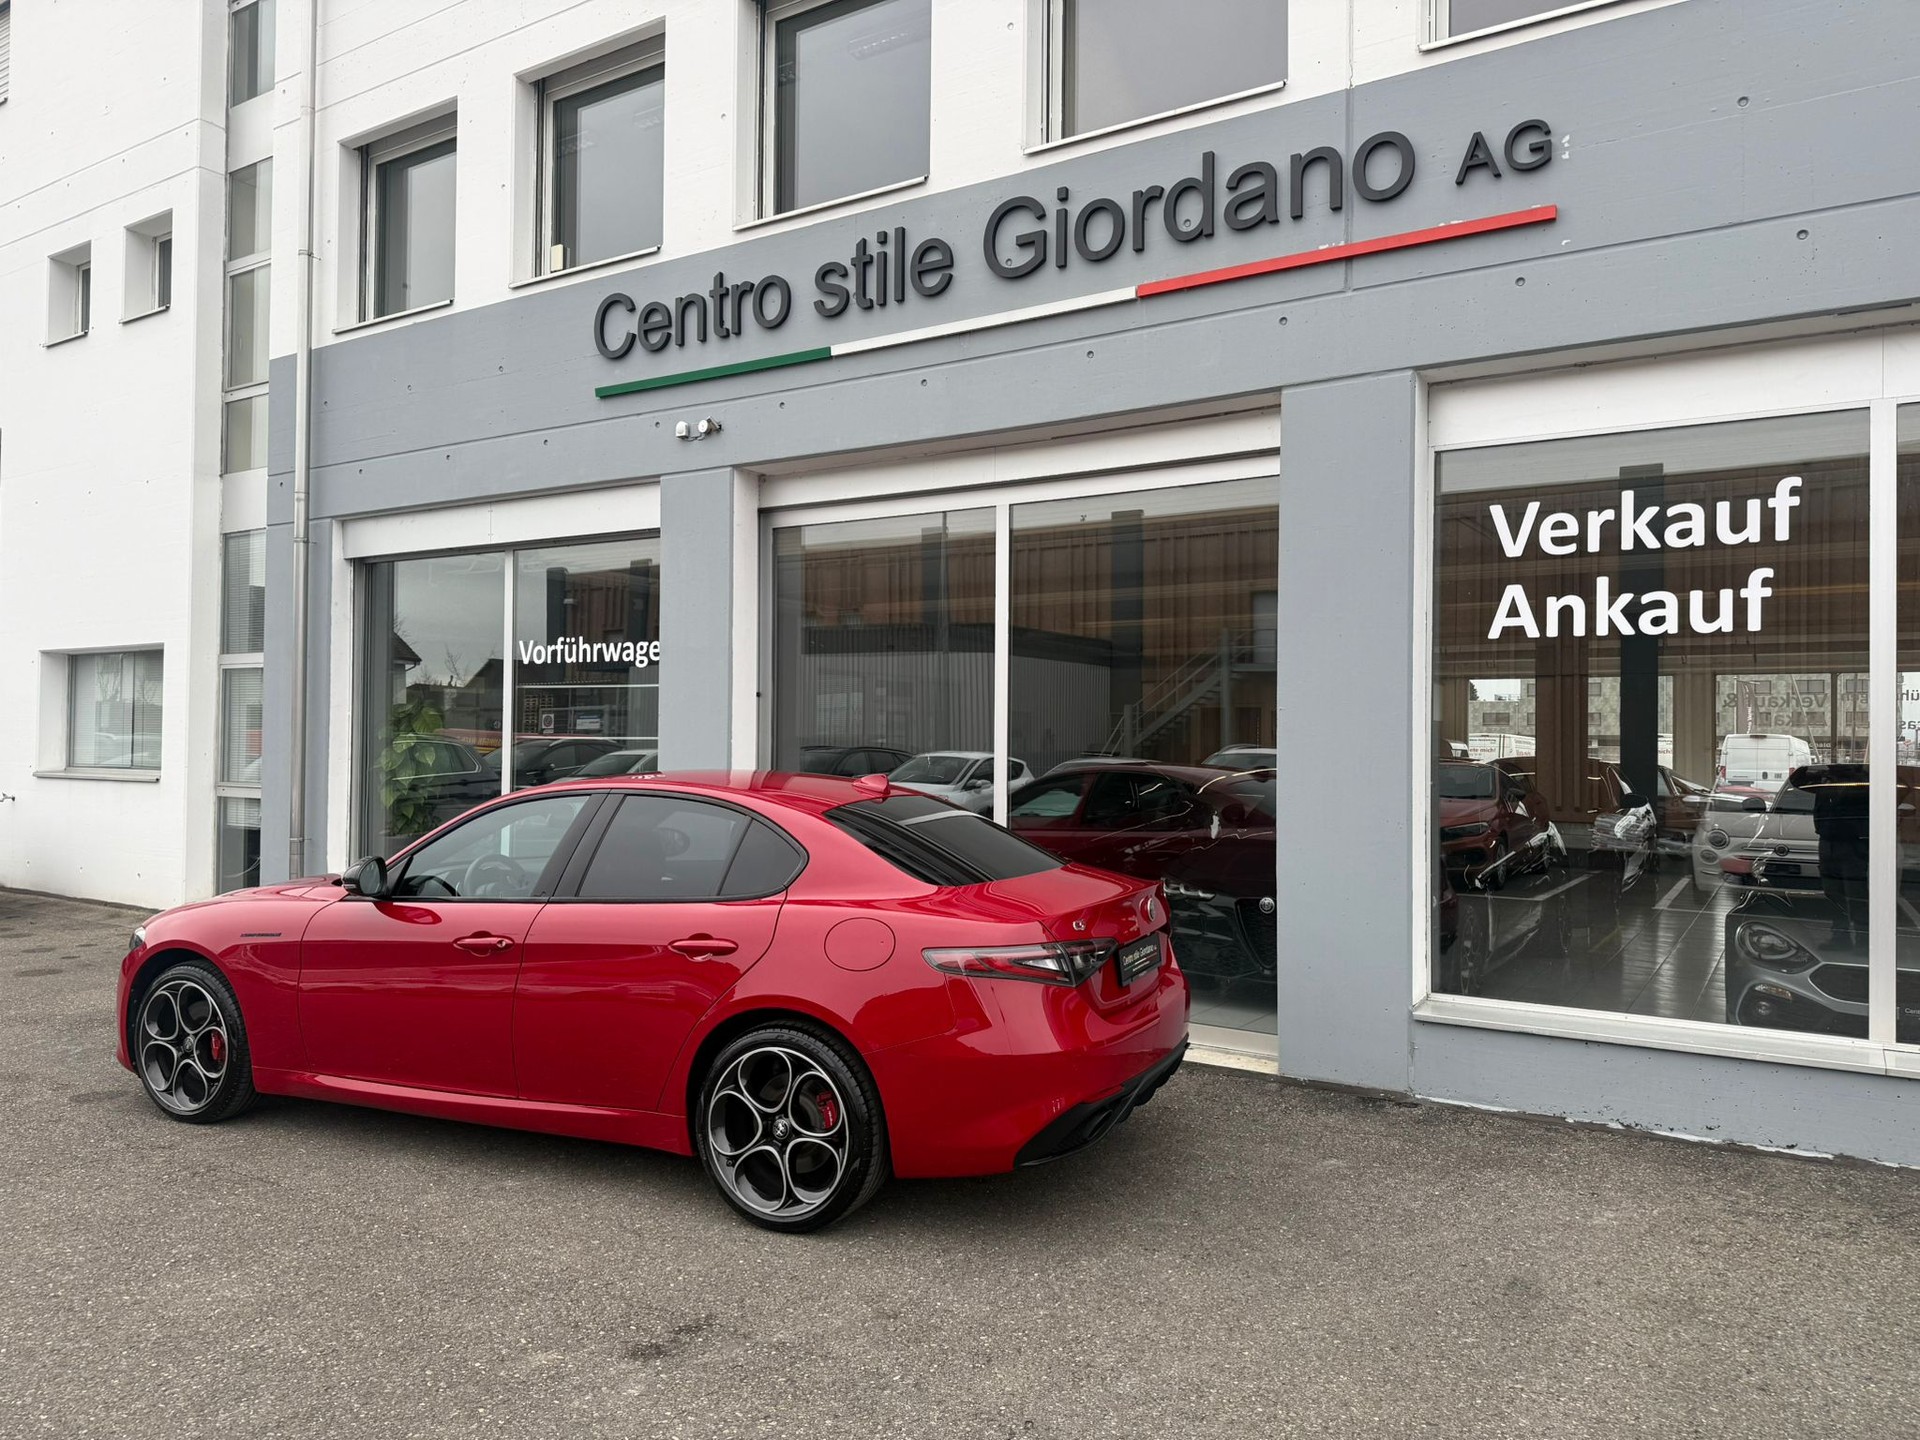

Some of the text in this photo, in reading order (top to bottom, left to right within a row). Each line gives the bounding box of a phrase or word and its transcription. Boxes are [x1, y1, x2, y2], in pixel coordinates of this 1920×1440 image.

[593, 119, 1553, 360] Centro stile Giordano AG
[1489, 476, 1803, 558] Verkauf
[1487, 567, 1775, 640] Ankauf
